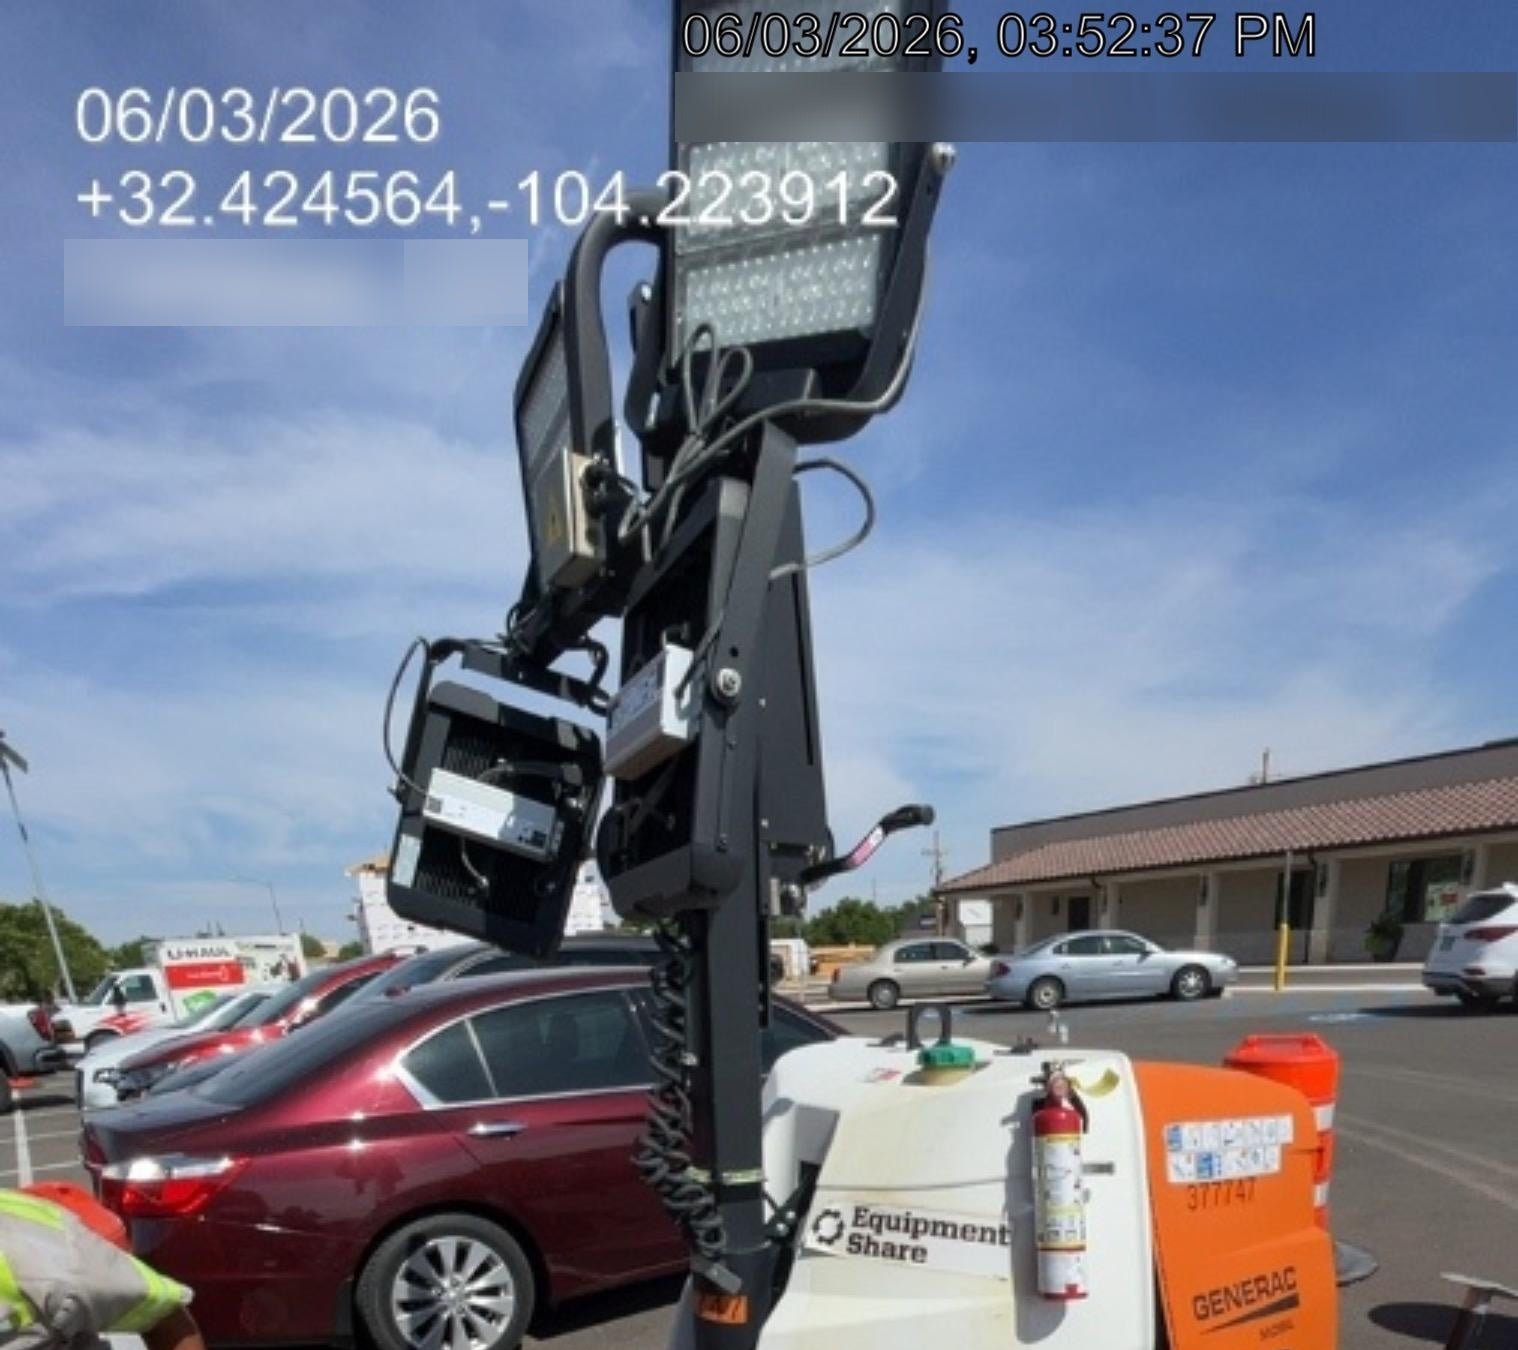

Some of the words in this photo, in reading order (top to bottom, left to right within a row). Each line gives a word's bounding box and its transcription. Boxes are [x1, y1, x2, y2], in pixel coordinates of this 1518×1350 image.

[1187, 1176, 1257, 1211] 377747
[851, 1205, 1011, 1246] Equipment
[847, 1232, 928, 1263] Share
[1193, 1265, 1297, 1321] GENERAC
